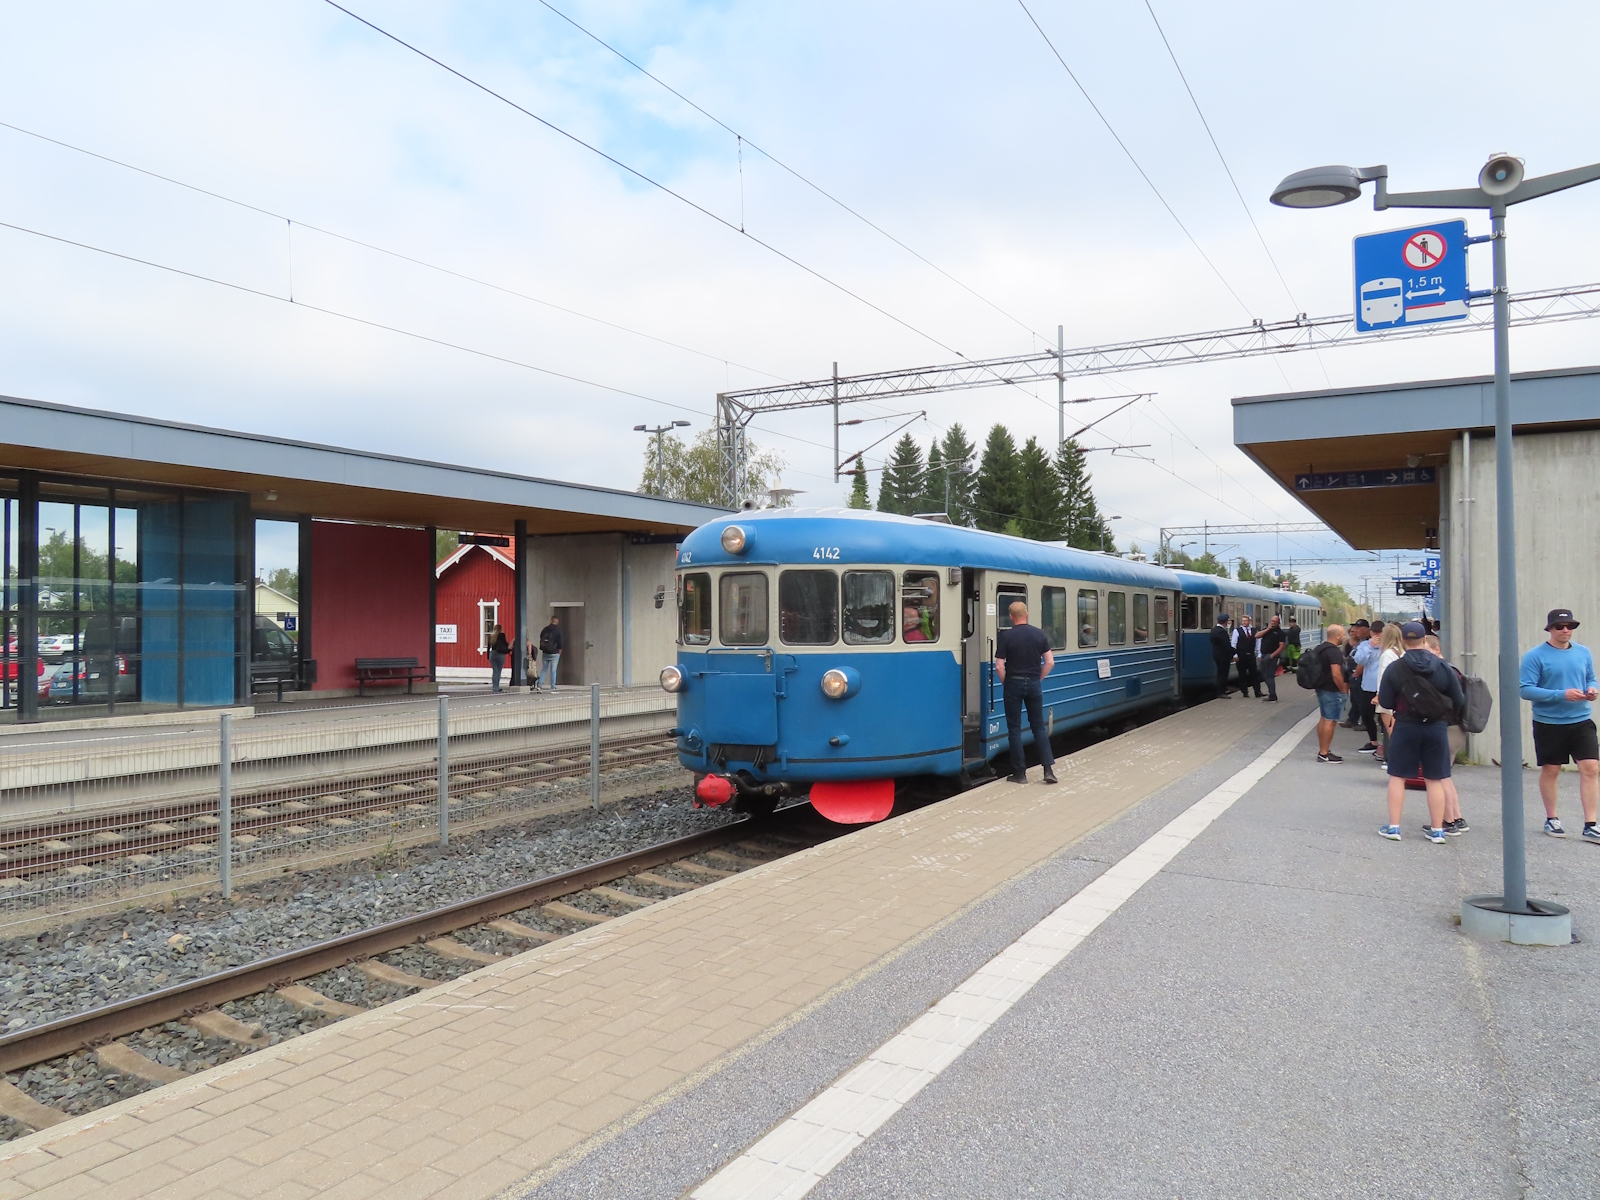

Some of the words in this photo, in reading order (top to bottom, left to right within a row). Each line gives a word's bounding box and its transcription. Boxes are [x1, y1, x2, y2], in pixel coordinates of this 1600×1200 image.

[1408, 276, 1427, 289] 1,5
[1430, 276, 1442, 285] m
[1360, 474, 1365, 483] 1
[813, 547, 840, 559] 4142
[1429, 560, 1437, 569] B
